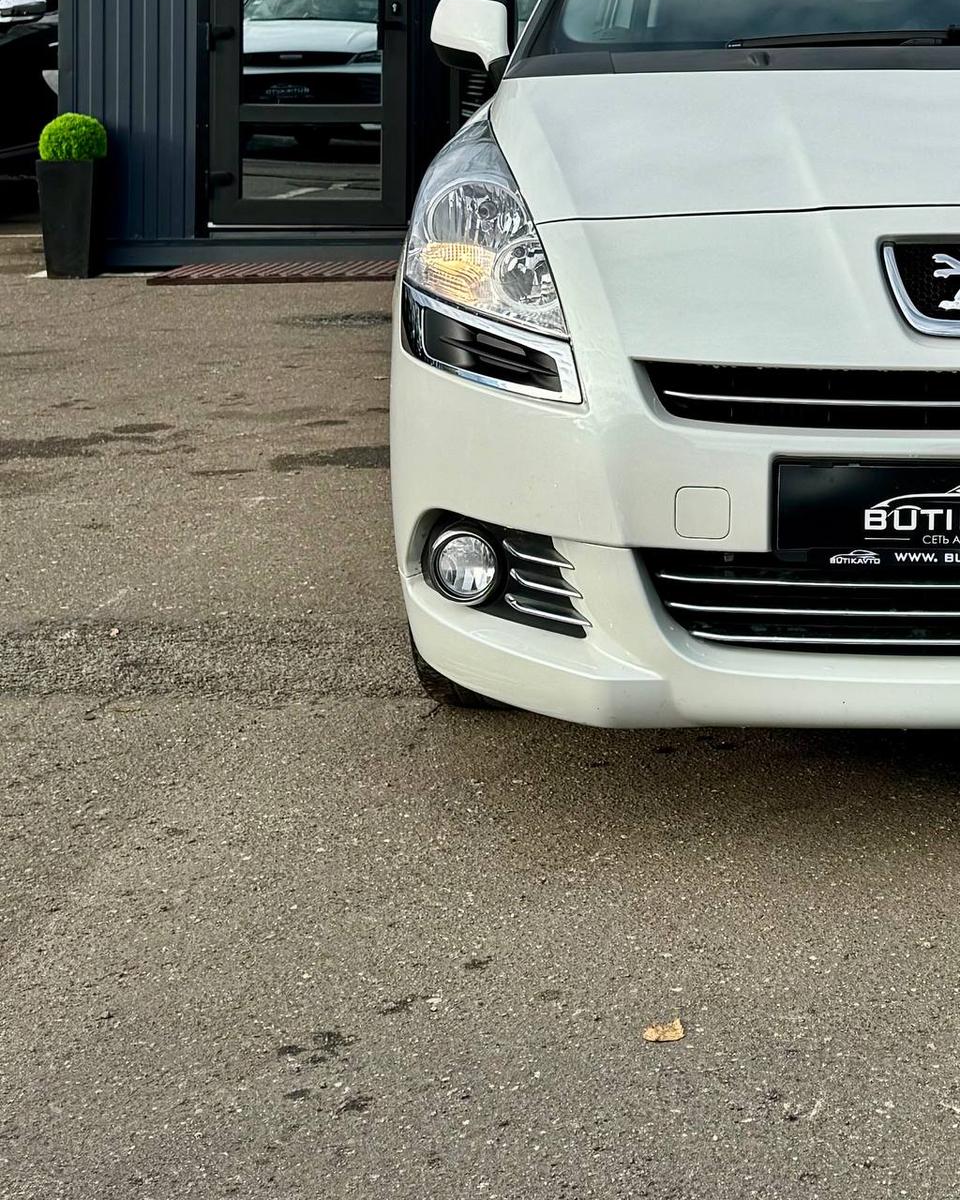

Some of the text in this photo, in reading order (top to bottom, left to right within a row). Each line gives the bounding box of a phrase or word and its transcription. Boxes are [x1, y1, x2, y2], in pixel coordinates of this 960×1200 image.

[922, 535, 949, 545] СЕТЬ
[829, 557, 881, 565] BUTIKAVTO
[894, 552, 938, 563] WWW.
